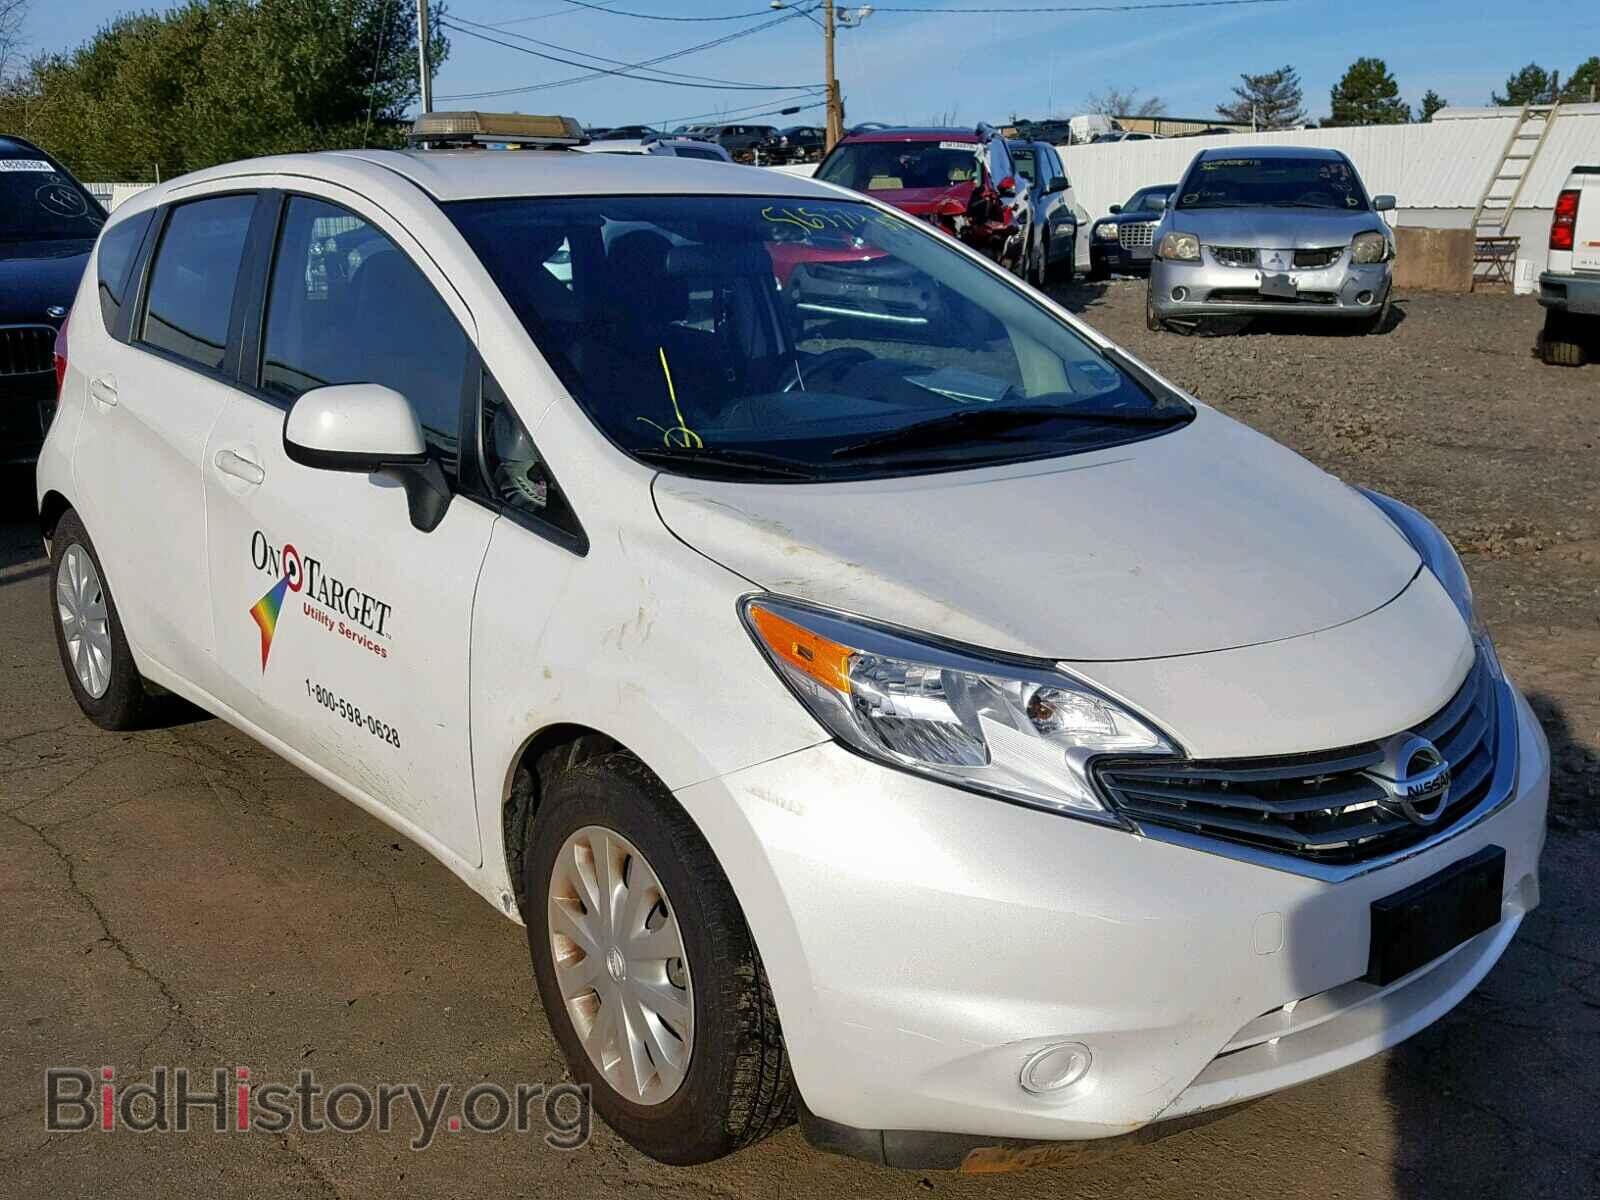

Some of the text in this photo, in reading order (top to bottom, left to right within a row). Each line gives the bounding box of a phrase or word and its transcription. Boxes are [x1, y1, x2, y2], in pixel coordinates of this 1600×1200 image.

[251, 530, 281, 578] ON
[303, 555, 391, 637] TARGET
[303, 602, 387, 658] Utility Services
[306, 678, 400, 748] 1-800-598-0628
